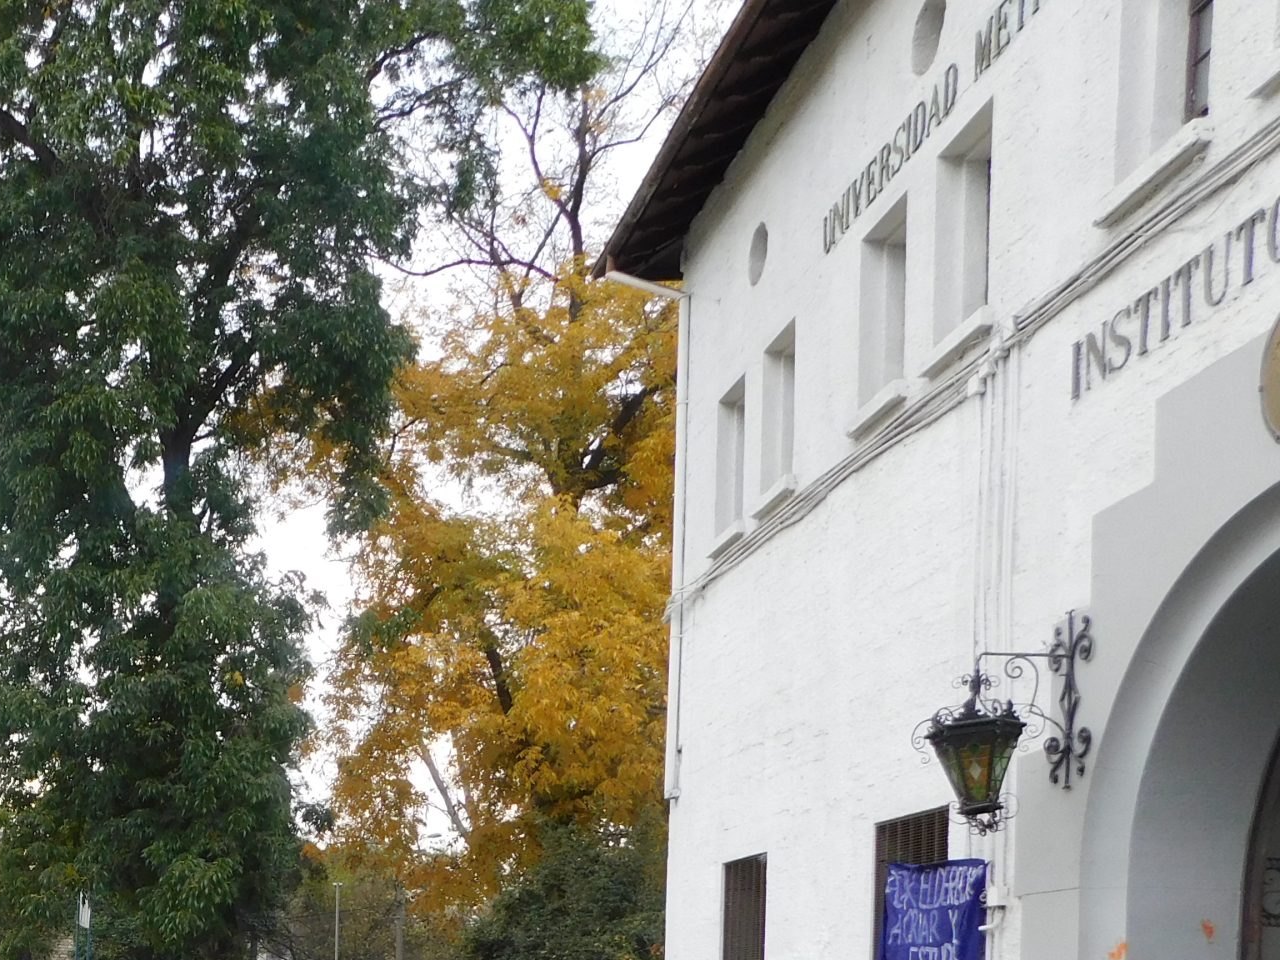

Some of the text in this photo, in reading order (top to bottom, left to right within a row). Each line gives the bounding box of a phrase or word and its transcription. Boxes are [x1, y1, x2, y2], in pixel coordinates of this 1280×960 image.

[823, 0, 1040, 254] UNIVERSIDAD MET
[948, 909, 959, 944] Y
